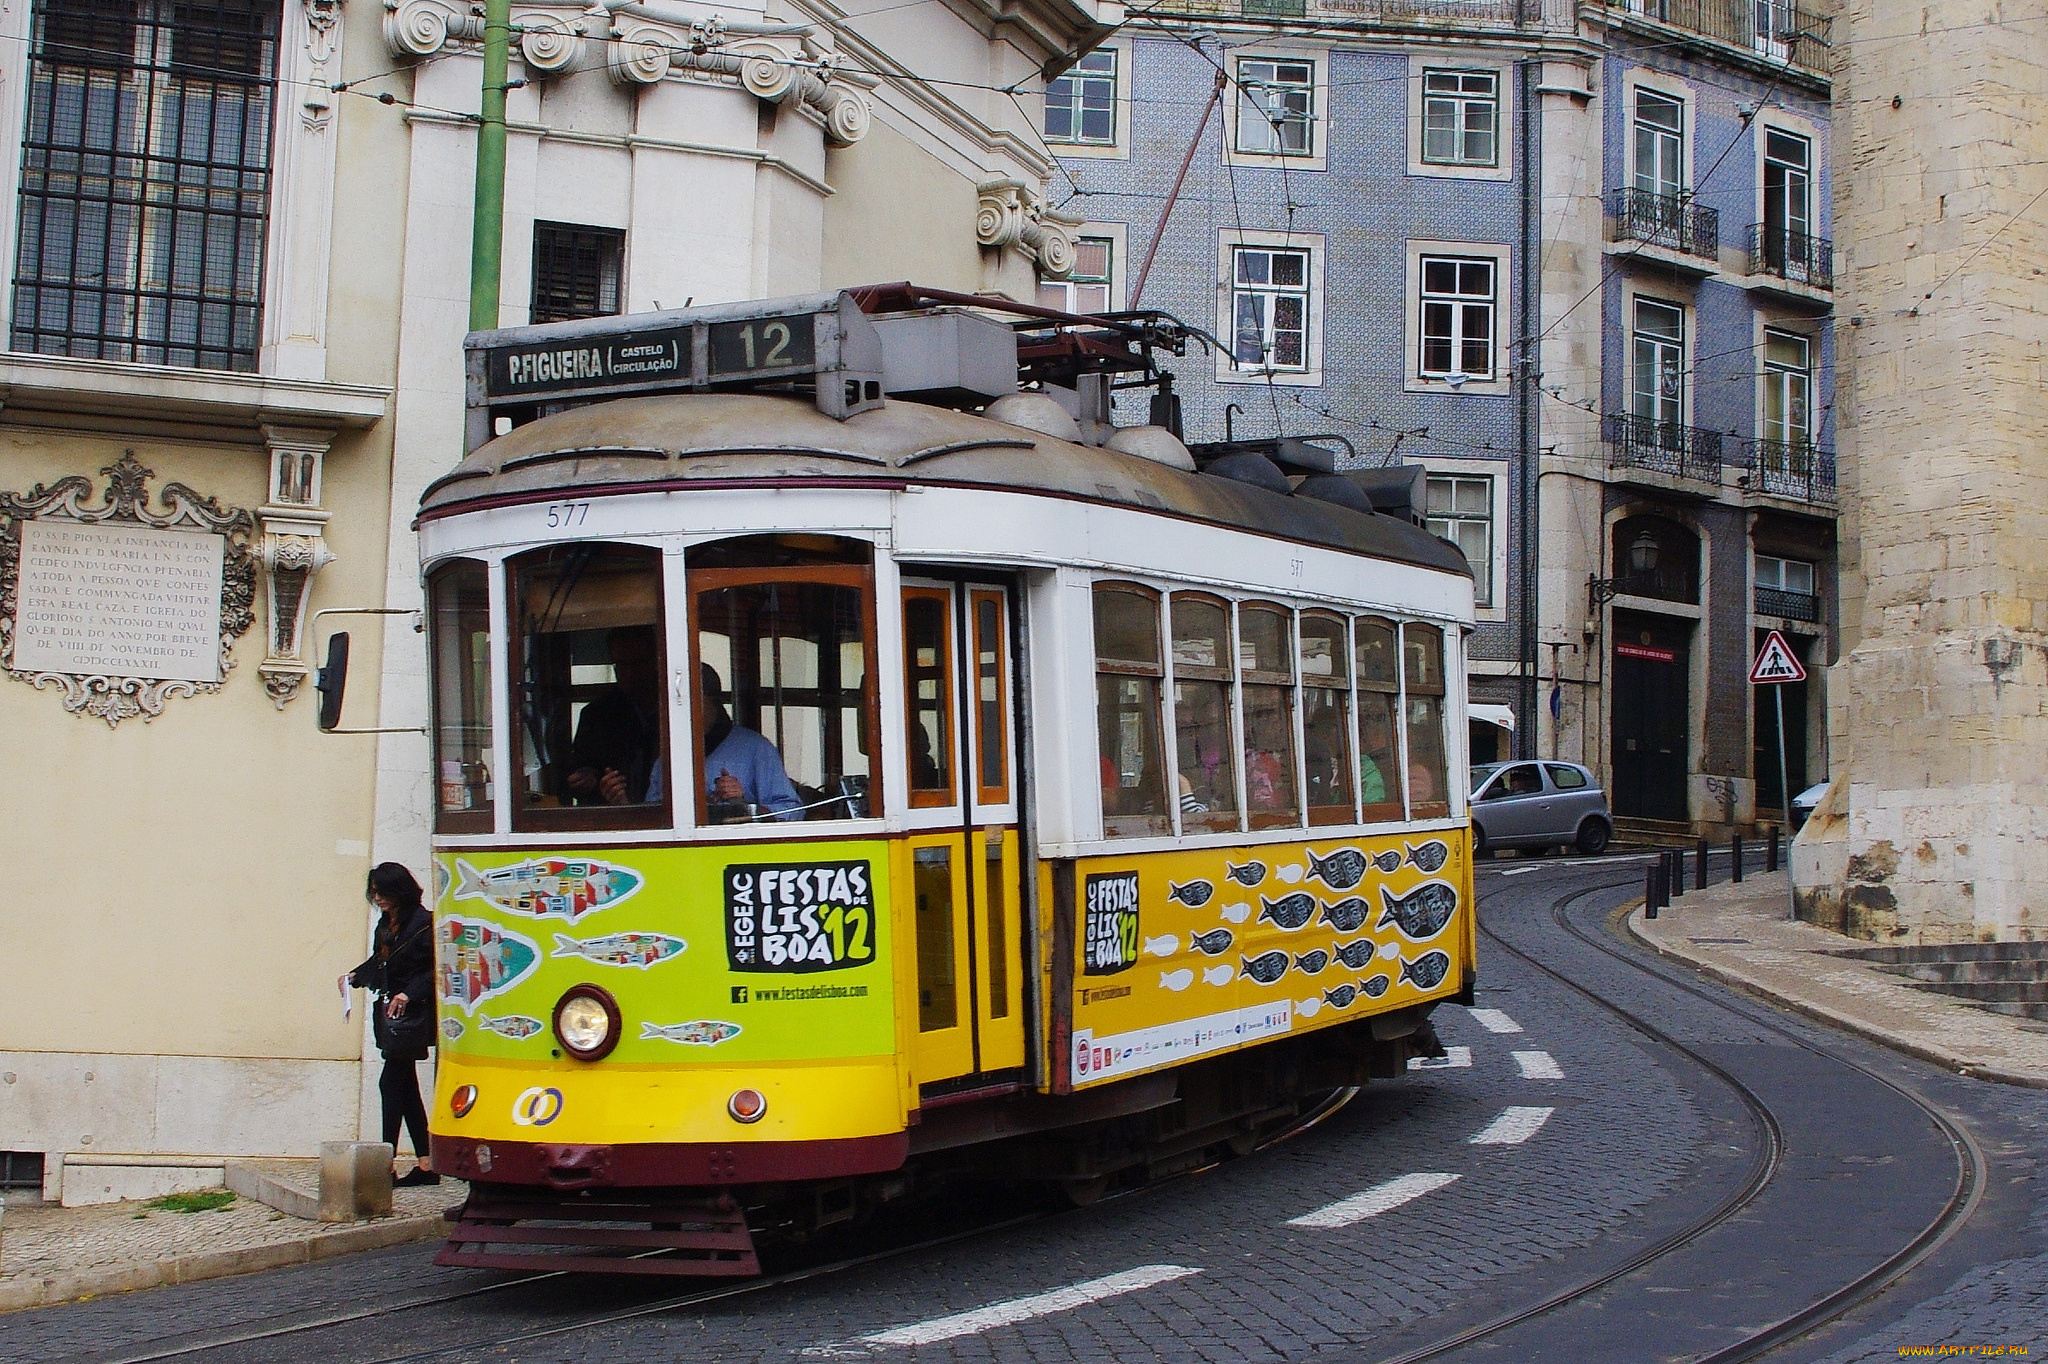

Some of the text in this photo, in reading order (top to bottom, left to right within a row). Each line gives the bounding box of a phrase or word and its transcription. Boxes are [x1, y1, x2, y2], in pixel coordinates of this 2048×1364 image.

[620, 344, 663, 358] CASTELO
[739, 321, 793, 368] 12
[508, 348, 603, 385] P.FIGUEIRA
[612, 358, 673, 375] CIRCULAÇÃO
[547, 503, 590, 528] 577
[32, 530, 41, 539] O
[74, 533, 93, 542] PIO
[126, 537, 189, 550] INSTANCIA
[31, 544, 80, 555] RAYNHA
[110, 549, 148, 560] MARIA
[30, 571, 38, 580] A
[42, 572, 73, 582] TODA
[79, 575, 86, 583] A
[91, 575, 131, 586] PESSOA
[28, 598, 55, 608] ESTA
[61, 600, 91, 610] REAL
[133, 605, 139, 614] E
[166, 593, 211, 605] VISITAR
[27, 612, 83, 623] GLORIOSO
[100, 617, 153, 628] ANTONIO
[157, 620, 173, 629] EM
[62, 627, 82, 637] DIA
[88, 629, 105, 638] DO
[146, 633, 167, 642] POR
[37, 639, 52, 648] DE
[111, 644, 175, 656] NOVEMBRO
[759, 866, 867, 906] FESTAS
[1097, 876, 1138, 912] FESTAS
[732, 872, 756, 947] EGEAC
[853, 896, 869, 905] DE
[761, 904, 820, 940] LIS
[1096, 912, 1120, 944] LIS
[762, 933, 834, 966] BOA
[1095, 938, 1122, 968] BOA
